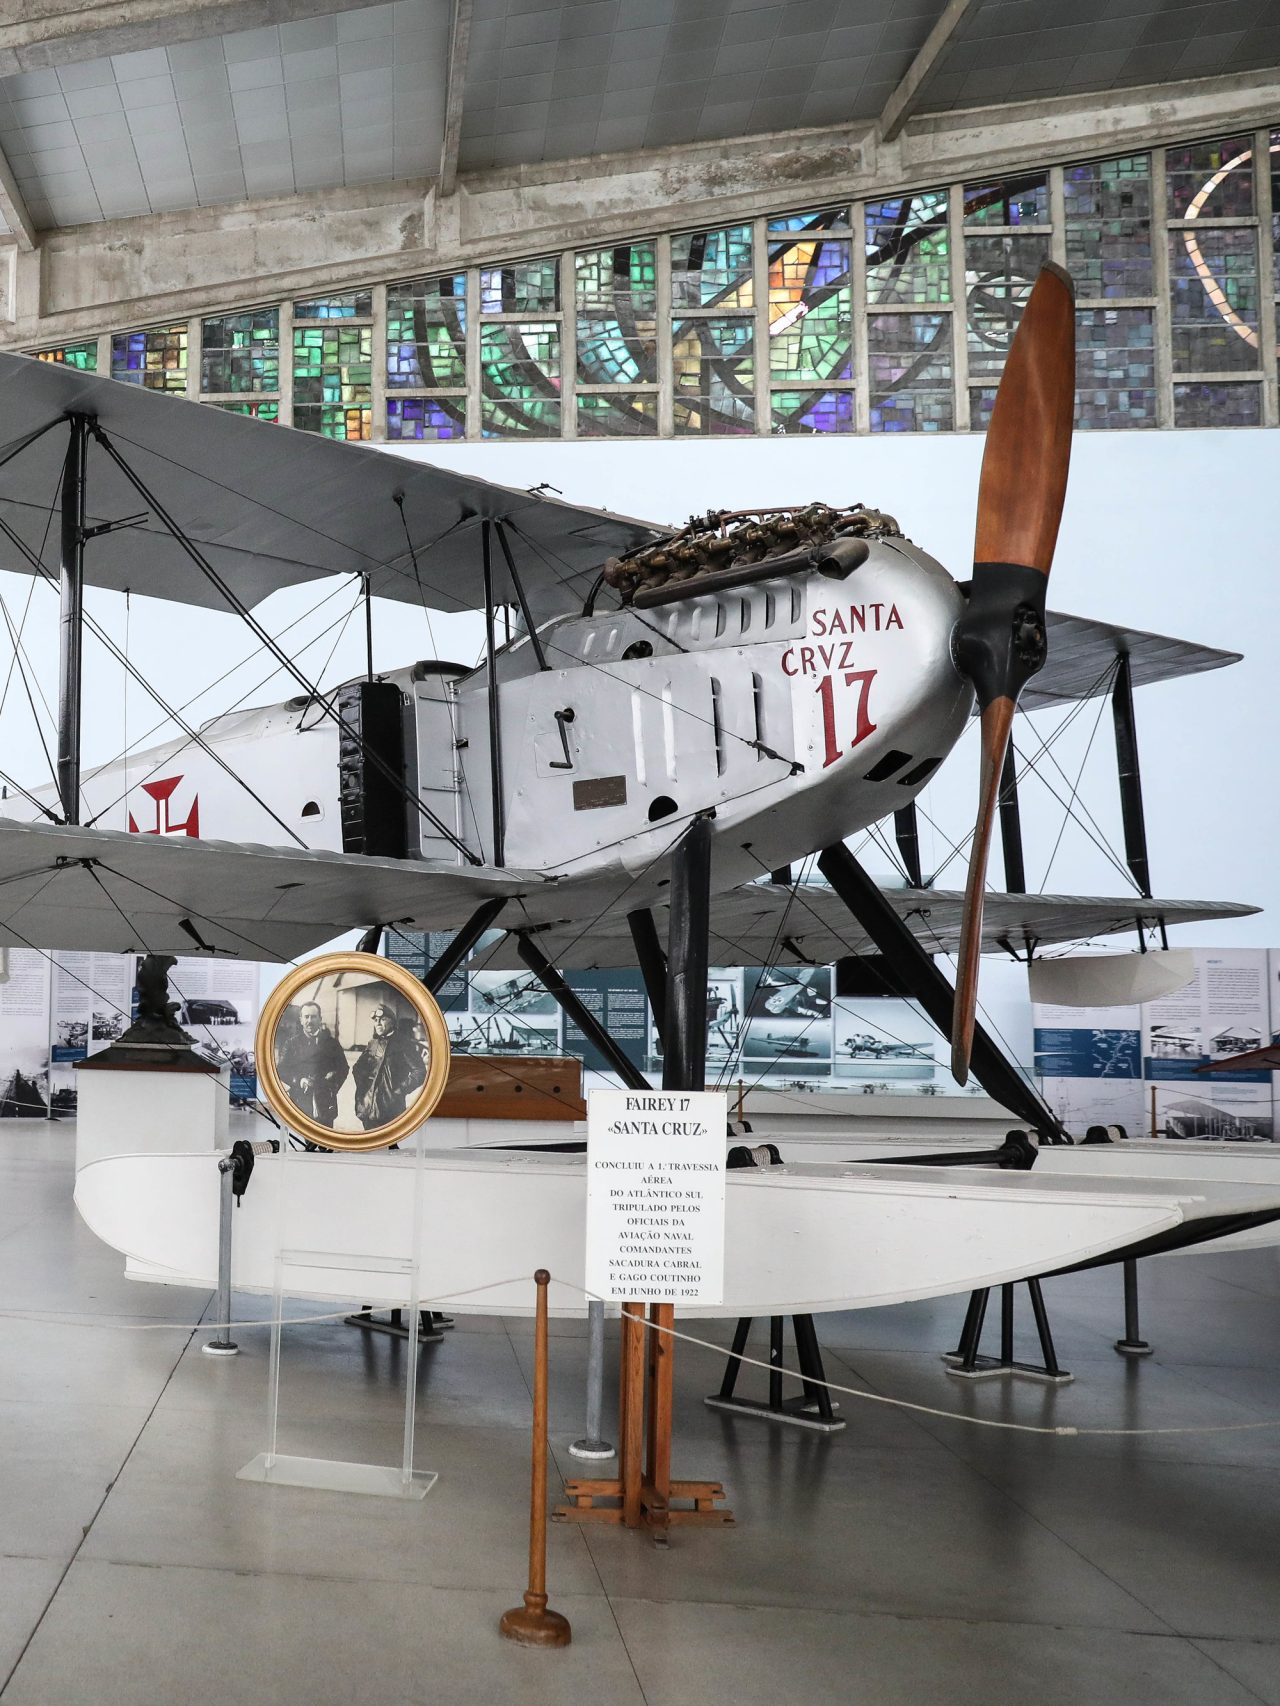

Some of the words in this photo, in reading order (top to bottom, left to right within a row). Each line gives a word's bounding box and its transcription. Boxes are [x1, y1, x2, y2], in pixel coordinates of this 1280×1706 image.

[812, 603, 904, 637] SANTA
[815, 669, 877, 768] 17
[626, 1097, 676, 1112] FAIREY
[680, 1098, 691, 1112] 17
[595, 1161, 644, 1170] CONCLUIU
[668, 1163, 719, 1171] TRAVESSIA
[641, 1174, 673, 1184] AÉREA
[610, 1189, 624, 1197] DO
[627, 1188, 682, 1198] ATLÂNTICO
[685, 1191, 703, 1199] SUL
[612, 1203, 667, 1212] TRIPULADO
[671, 1205, 701, 1213] PELOS
[627, 1217, 669, 1226] OFICIAIS
[672, 1218, 685, 1226] DA
[618, 1230, 660, 1241] AVIAÇÃO
[663, 1232, 694, 1240] NAVAL
[619, 1245, 692, 1254] COMANDANTES
[609, 1259, 660, 1268] SACADURA
[663, 1260, 702, 1269] CABRAL
[609, 1273, 616, 1281] E
[619, 1273, 647, 1281] GAGO
[650, 1274, 701, 1283] COUTINHO
[611, 1287, 626, 1295] EM
[629, 1287, 661, 1296] JUNHO
[664, 1288, 677, 1296] DE
[681, 1288, 699, 1297] 1922
